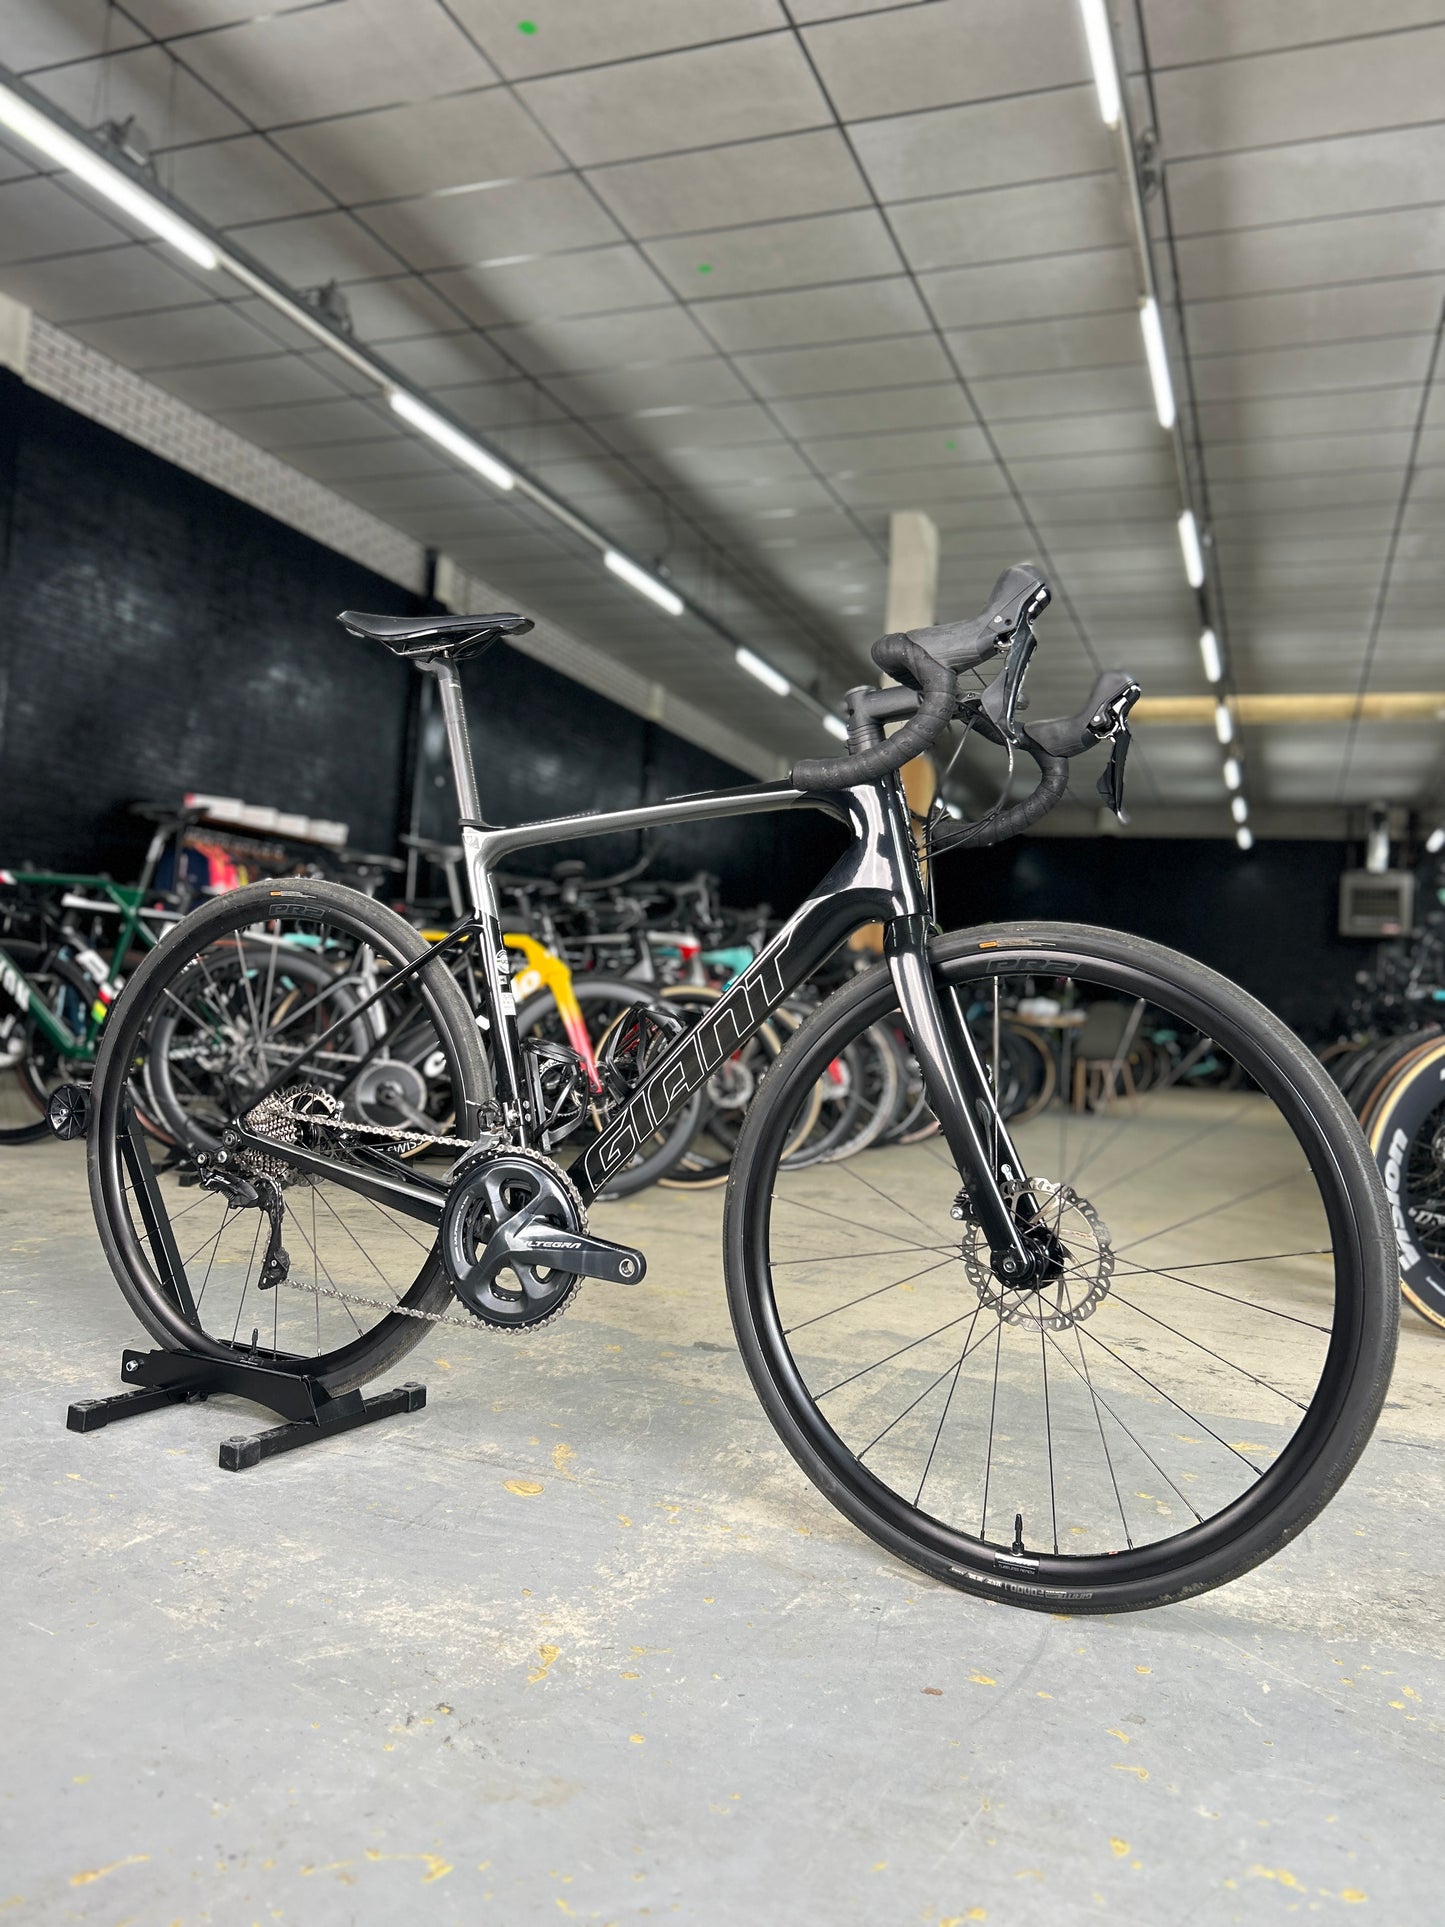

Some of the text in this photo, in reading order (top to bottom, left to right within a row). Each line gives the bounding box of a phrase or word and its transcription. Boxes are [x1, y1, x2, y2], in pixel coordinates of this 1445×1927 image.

[268, 903, 326, 919] PR2
[985, 957, 1081, 974] PR2
[584, 926, 797, 1194] GIANT
